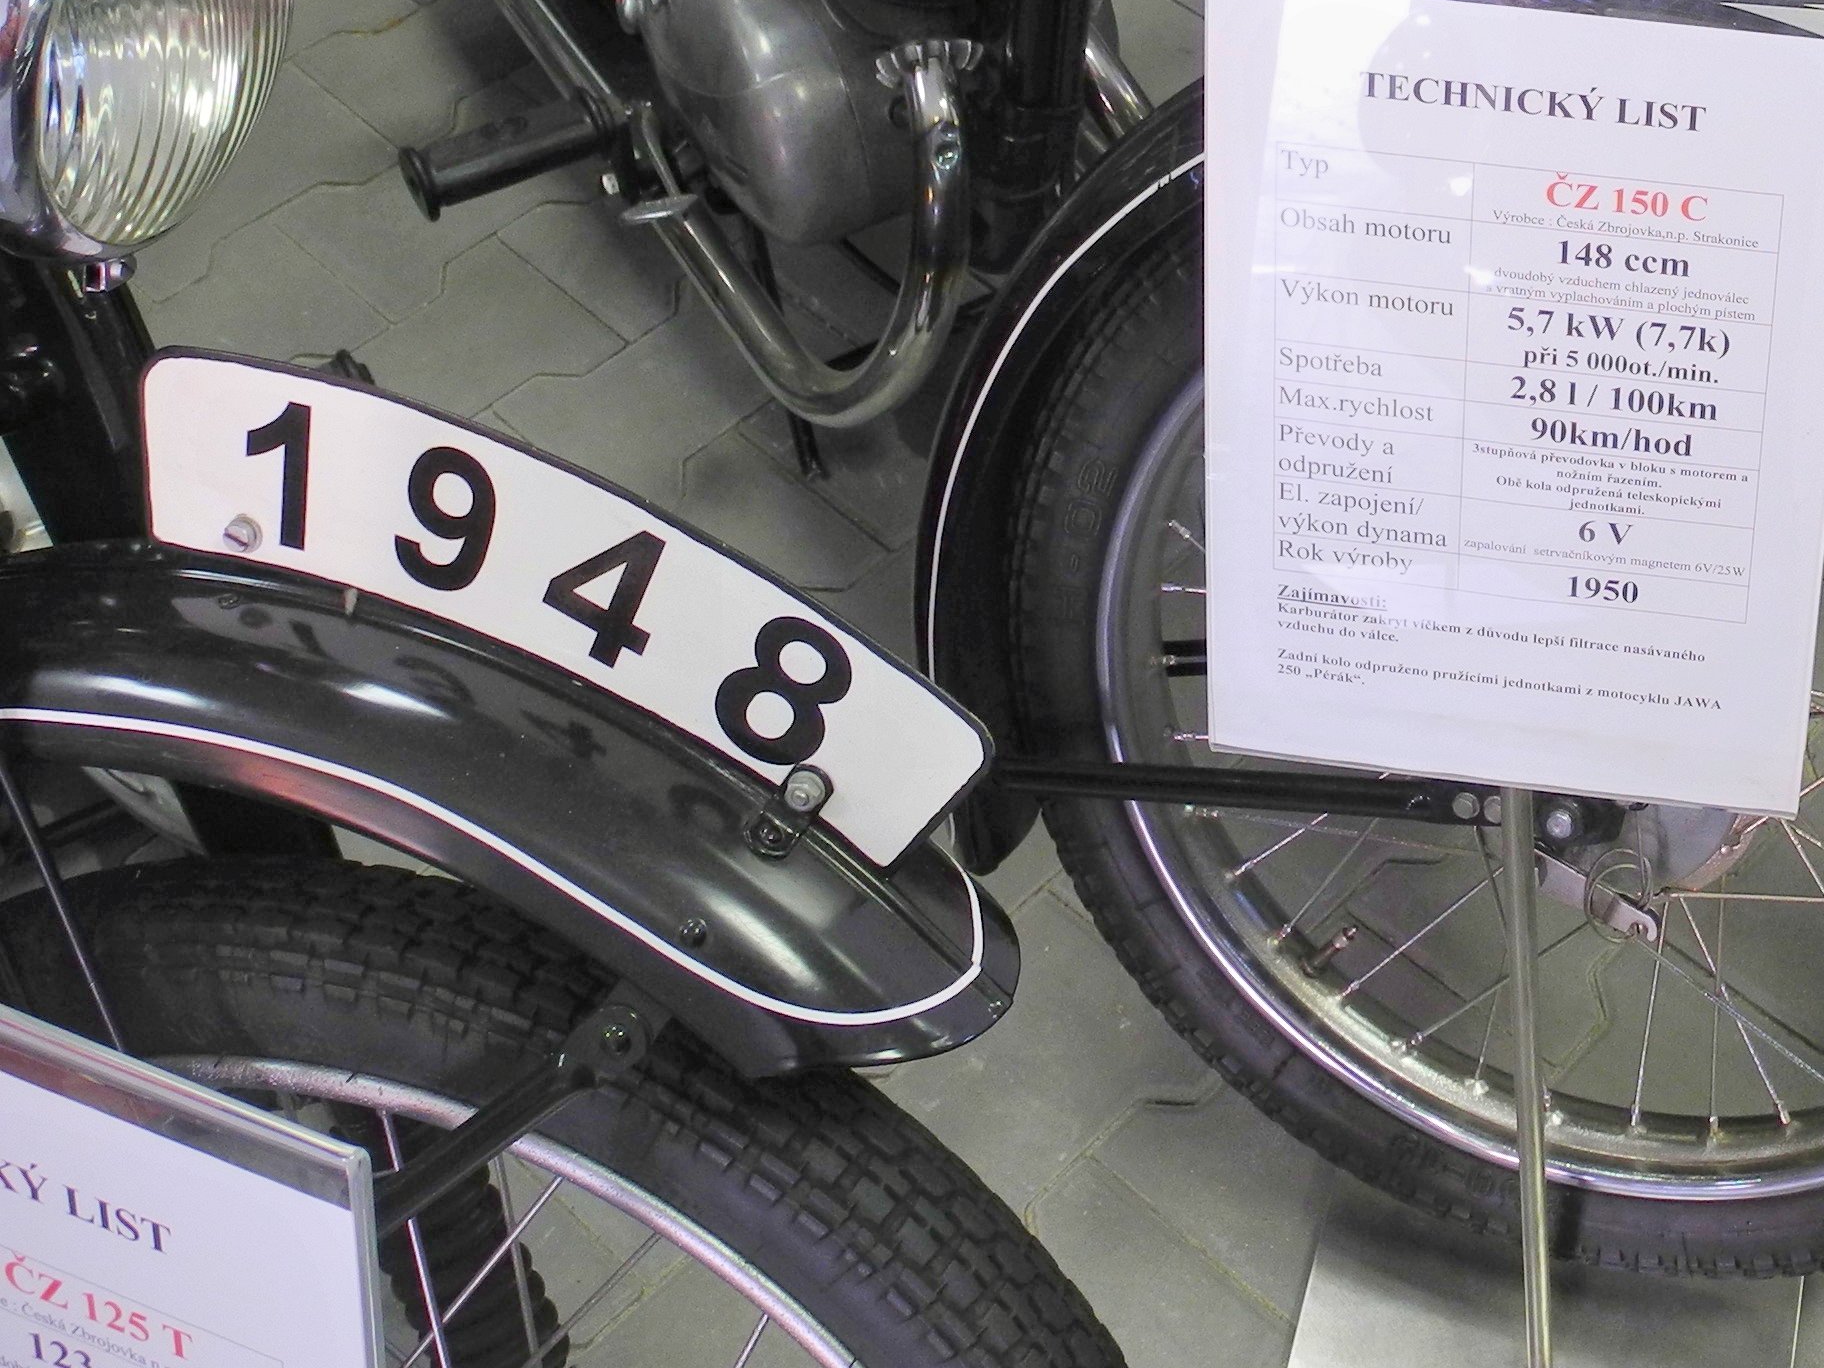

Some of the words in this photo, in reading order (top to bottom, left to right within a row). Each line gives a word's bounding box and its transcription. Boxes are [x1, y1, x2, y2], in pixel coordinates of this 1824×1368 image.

[1359, 70, 1606, 122] TECHNICKÝ
[1614, 96, 1708, 133] LIST
[1545, 171, 1600, 211] ČZ
[1613, 187, 1670, 218] 150
[1680, 194, 1709, 222] C
[1280, 208, 1356, 235] Obsah
[1364, 221, 1452, 245] motoru
[1559, 239, 1613, 270] 148
[1624, 253, 1690, 278] ccm
[1280, 278, 1359, 306] Výkon
[1368, 293, 1454, 317] motoru
[1493, 266, 1555, 287] dvoudobý
[1557, 275, 1621, 291] vzduchem
[1624, 280, 1680, 300] chlazený
[1681, 286, 1750, 306] jednoválec
[1507, 306, 1555, 337] 5,7
[1565, 312, 1625, 342] kW
[1635, 320, 1731, 360] (7,7k)
[1279, 346, 1383, 378] Spotřeba
[1523, 346, 1558, 368] při
[1565, 349, 1579, 368] 5
[1279, 385, 1434, 423] Max.rychlost
[1279, 423, 1375, 458] Převody
[1381, 441, 1395, 456] a
[1530, 416, 1693, 457] 90km/hod
[1277, 454, 1393, 484] odpružení
[1279, 481, 1309, 503] El.
[1317, 491, 1425, 516] zapojení/
[1278, 511, 1348, 536] výkon
[1356, 519, 1448, 548] dynama
[1578, 520, 1597, 543] 6
[1607, 521, 1634, 546] V
[1278, 538, 1324, 562] Rok
[1332, 546, 1413, 576] výroby
[245, 401, 853, 765] 1948
[1569, 575, 1639, 604] 1950
[1277, 648, 1318, 664] Zadní
[1322, 653, 1352, 668] kolo
[1354, 659, 1429, 677] odpruženo
[1432, 670, 1499, 686] pružícími
[1501, 675, 1582, 695] jednotkami
[1585, 687, 1594, 697] z
[1597, 688, 1670, 706] motocyklu
[1673, 695, 1722, 710] JAWA
[64, 1185, 172, 1253] LIST
[4, 1250, 69, 1310] ČZ
[83, 1292, 150, 1342] 125
[162, 1323, 193, 1360] T
